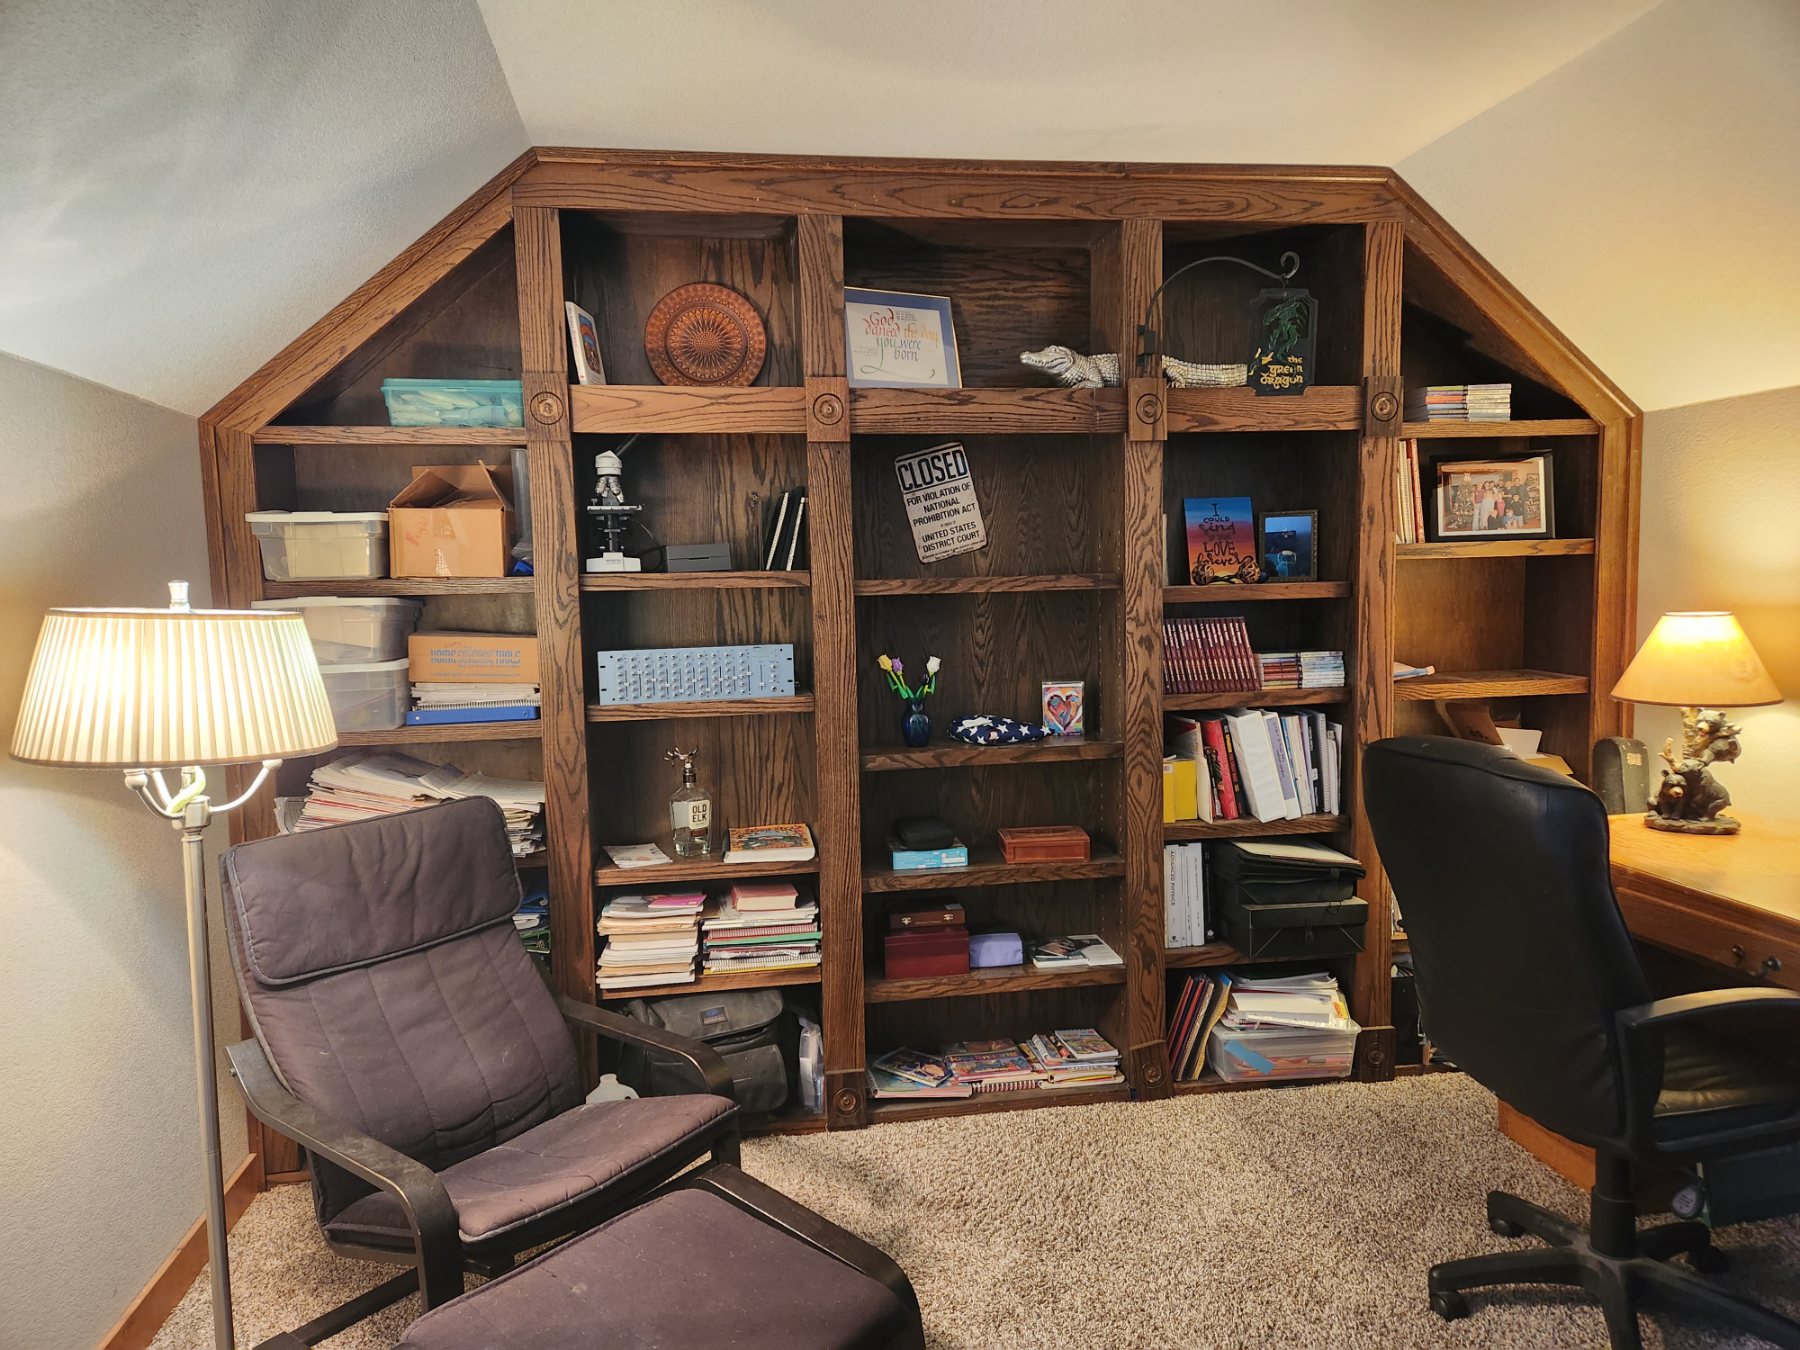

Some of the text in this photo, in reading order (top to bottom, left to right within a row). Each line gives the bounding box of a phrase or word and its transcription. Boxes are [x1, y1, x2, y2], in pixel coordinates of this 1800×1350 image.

[870, 308, 894, 326] God
[862, 318, 900, 337] danced
[899, 339, 921, 350] were
[894, 347, 919, 361] born
[897, 450, 968, 491] CLOSED
[907, 482, 971, 506] FOR VIOLATION OF
[923, 497, 960, 513] NATIONAL
[1211, 503, 1219, 516] I
[913, 507, 960, 527] PROHIBITION
[961, 502, 976, 514] ACT
[922, 529, 949, 543] UNITED
[949, 521, 977, 535] STATES
[922, 536, 956, 553] DISTRICT
[957, 530, 980, 544] COURT
[1203, 541, 1235, 556] LOVE
[692, 804, 707, 814] OLD
[692, 813, 707, 823] ELK
